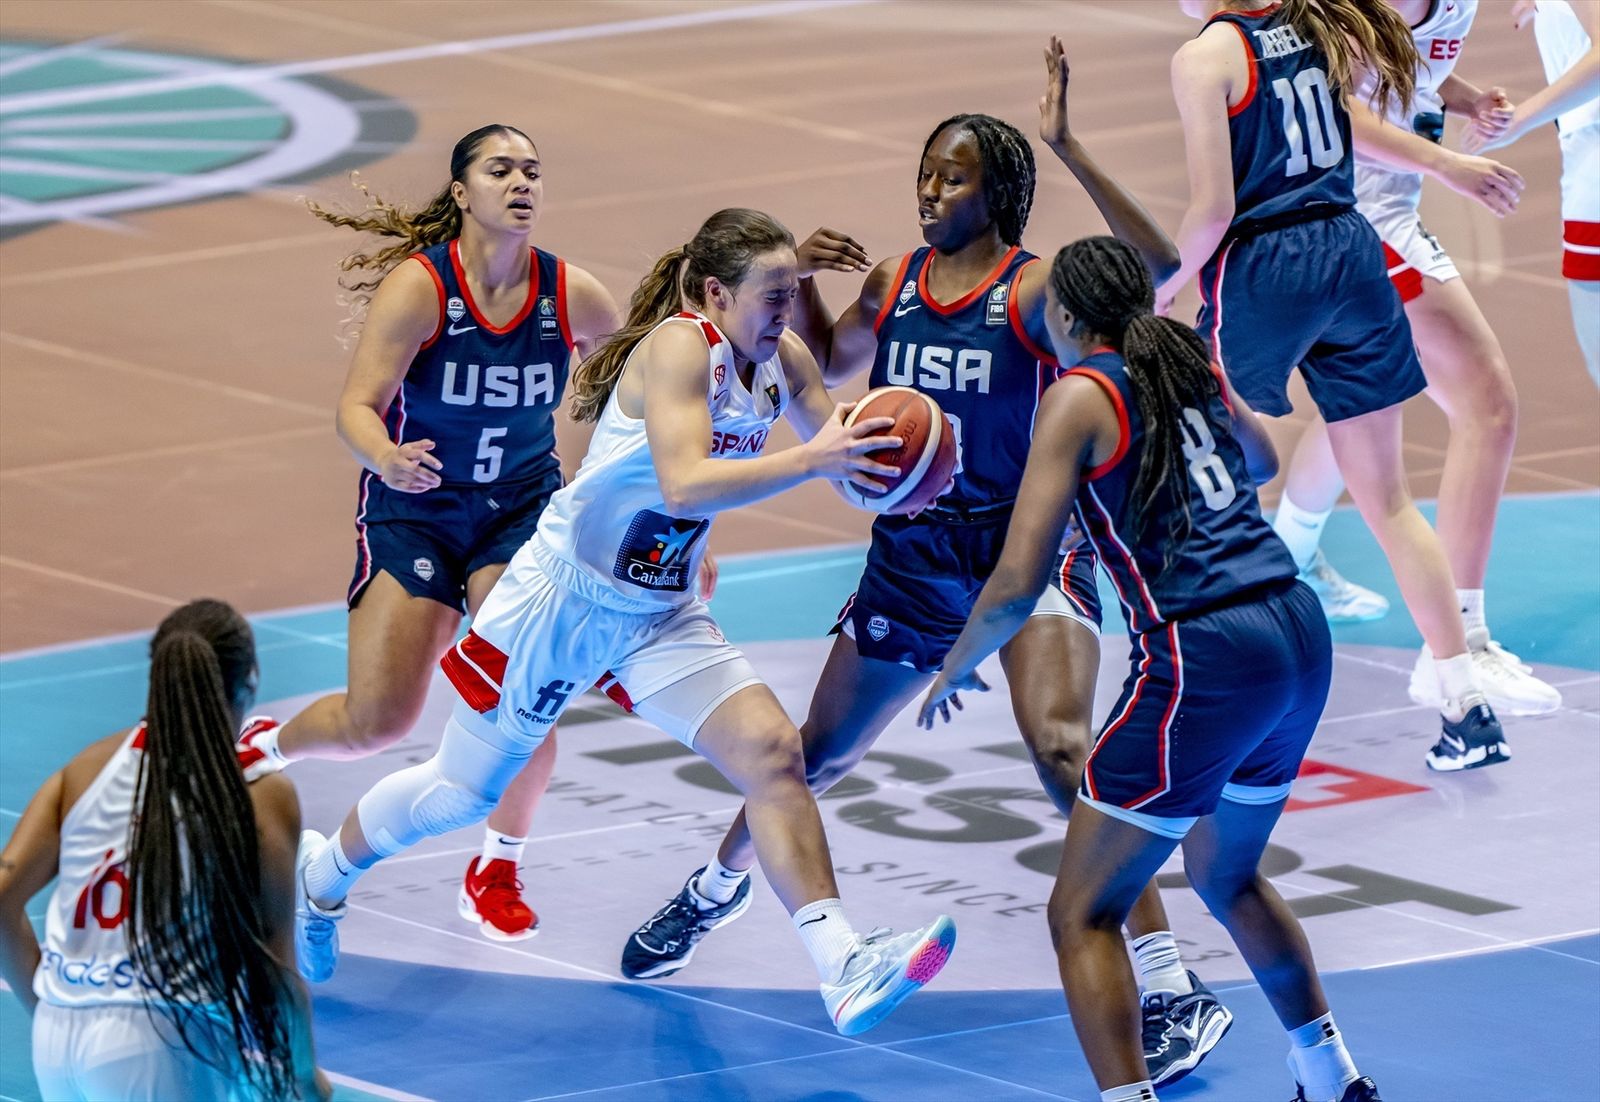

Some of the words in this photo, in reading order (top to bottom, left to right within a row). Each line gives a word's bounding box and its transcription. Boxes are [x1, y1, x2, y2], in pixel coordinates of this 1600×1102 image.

[1429, 37, 1466, 60] ES
[1272, 67, 1344, 178] 10
[441, 361, 554, 407] USA
[887, 341, 993, 394] USA
[472, 427, 508, 483] 5
[1178, 406, 1237, 511] 8
[837, 861, 1047, 918] SINCE
